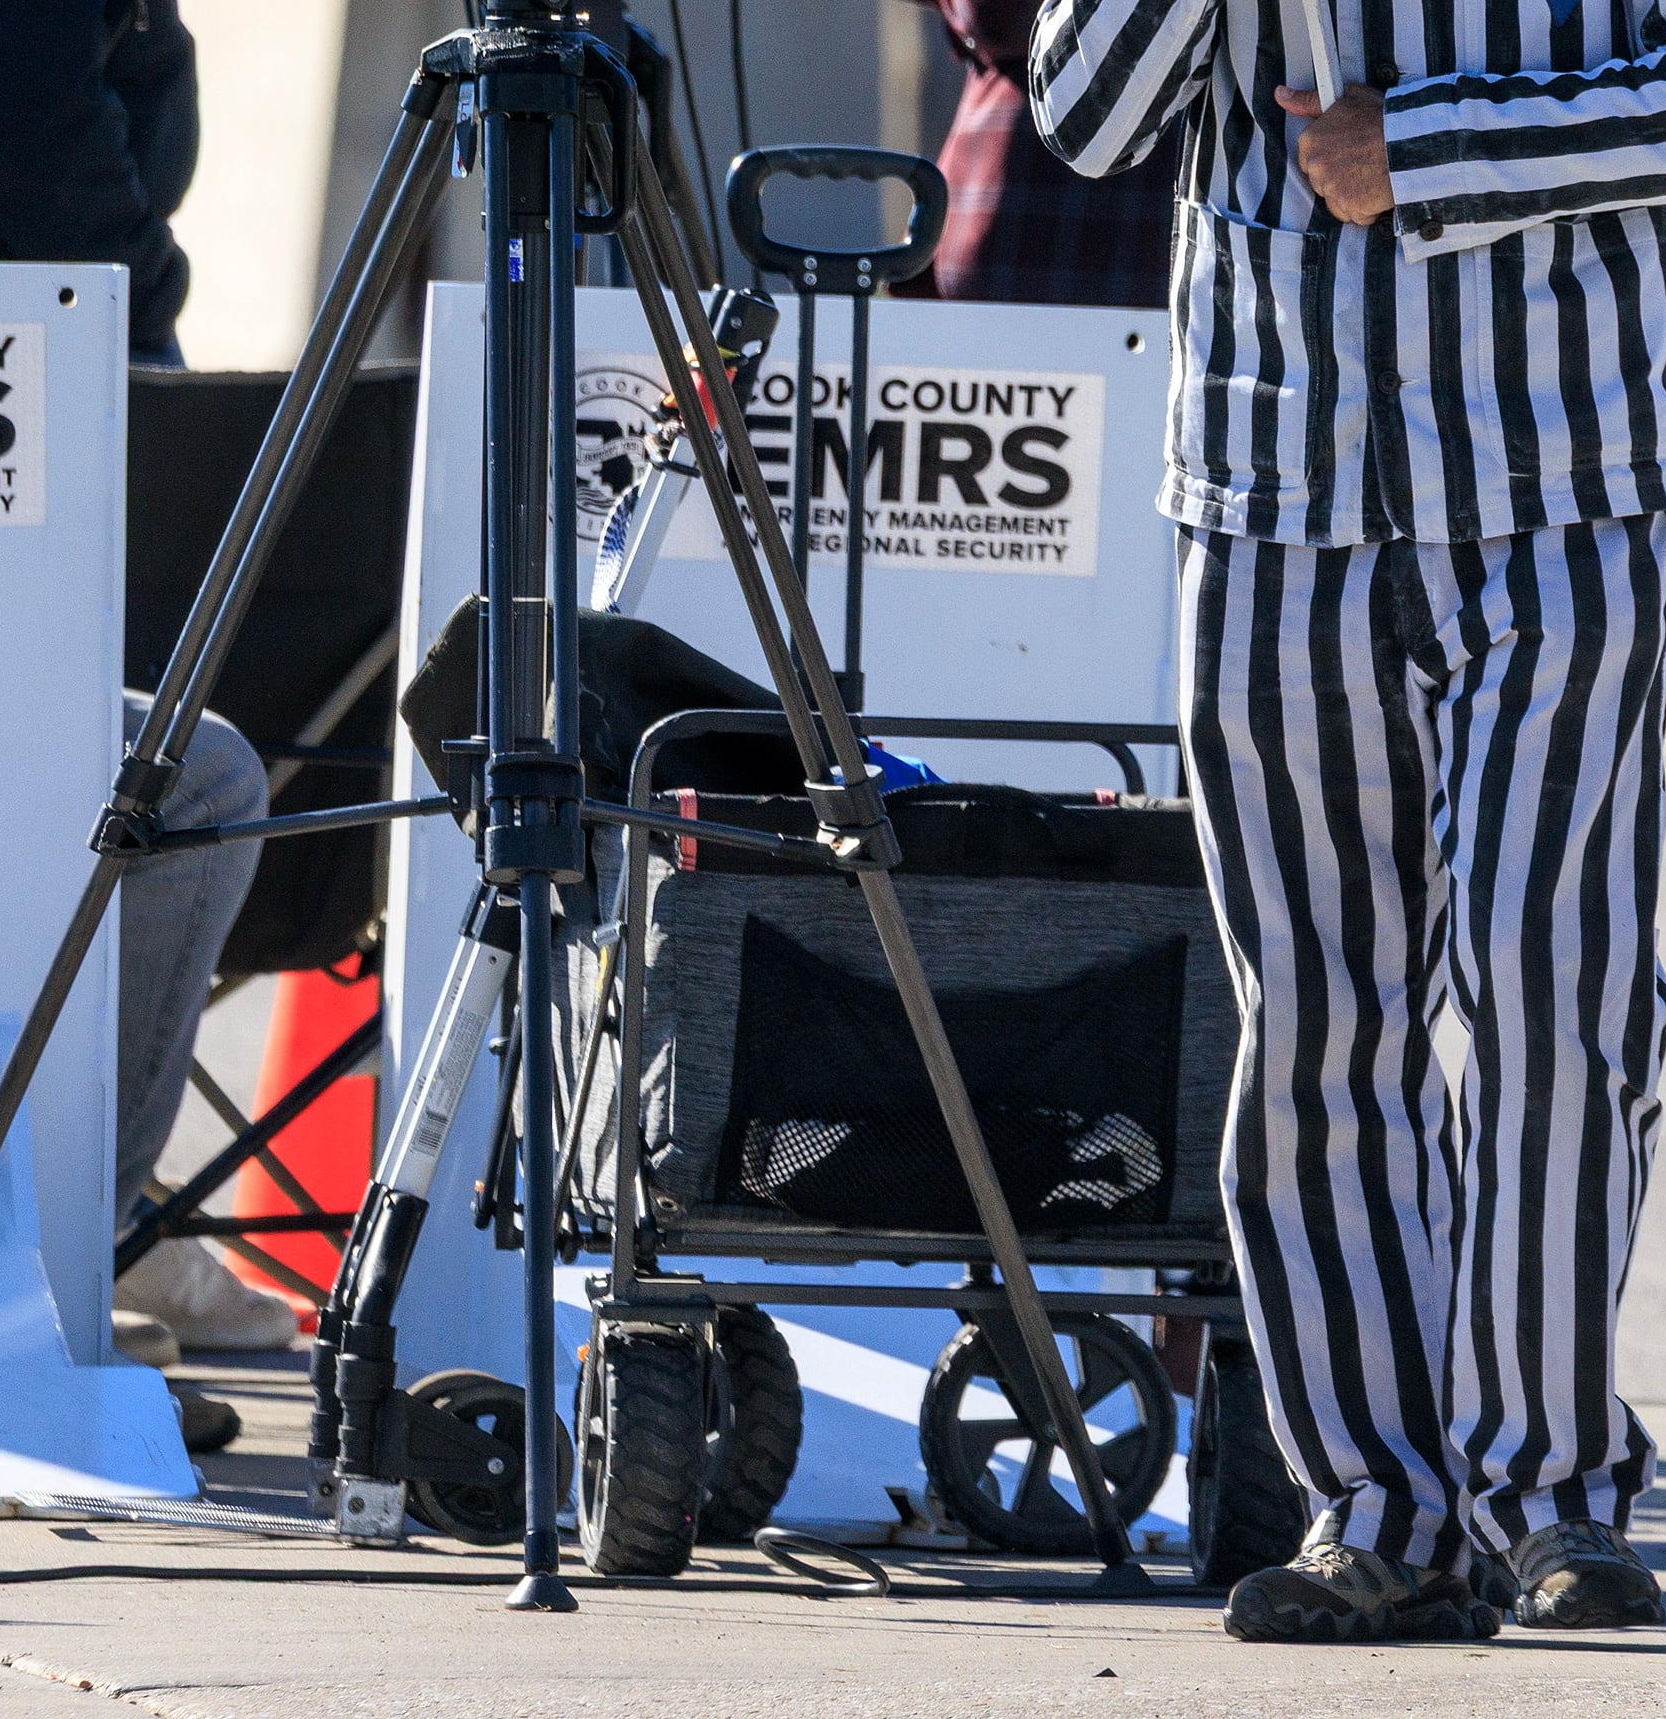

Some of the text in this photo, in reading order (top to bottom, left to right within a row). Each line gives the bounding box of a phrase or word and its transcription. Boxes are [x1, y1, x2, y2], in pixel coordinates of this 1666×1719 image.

[748, 374, 1075, 418] OOK COUNTY
[726, 414, 1072, 510] EMRS
[889, 511, 1072, 537] MANAGEMENT
[936, 538, 1070, 562] SECURITY
